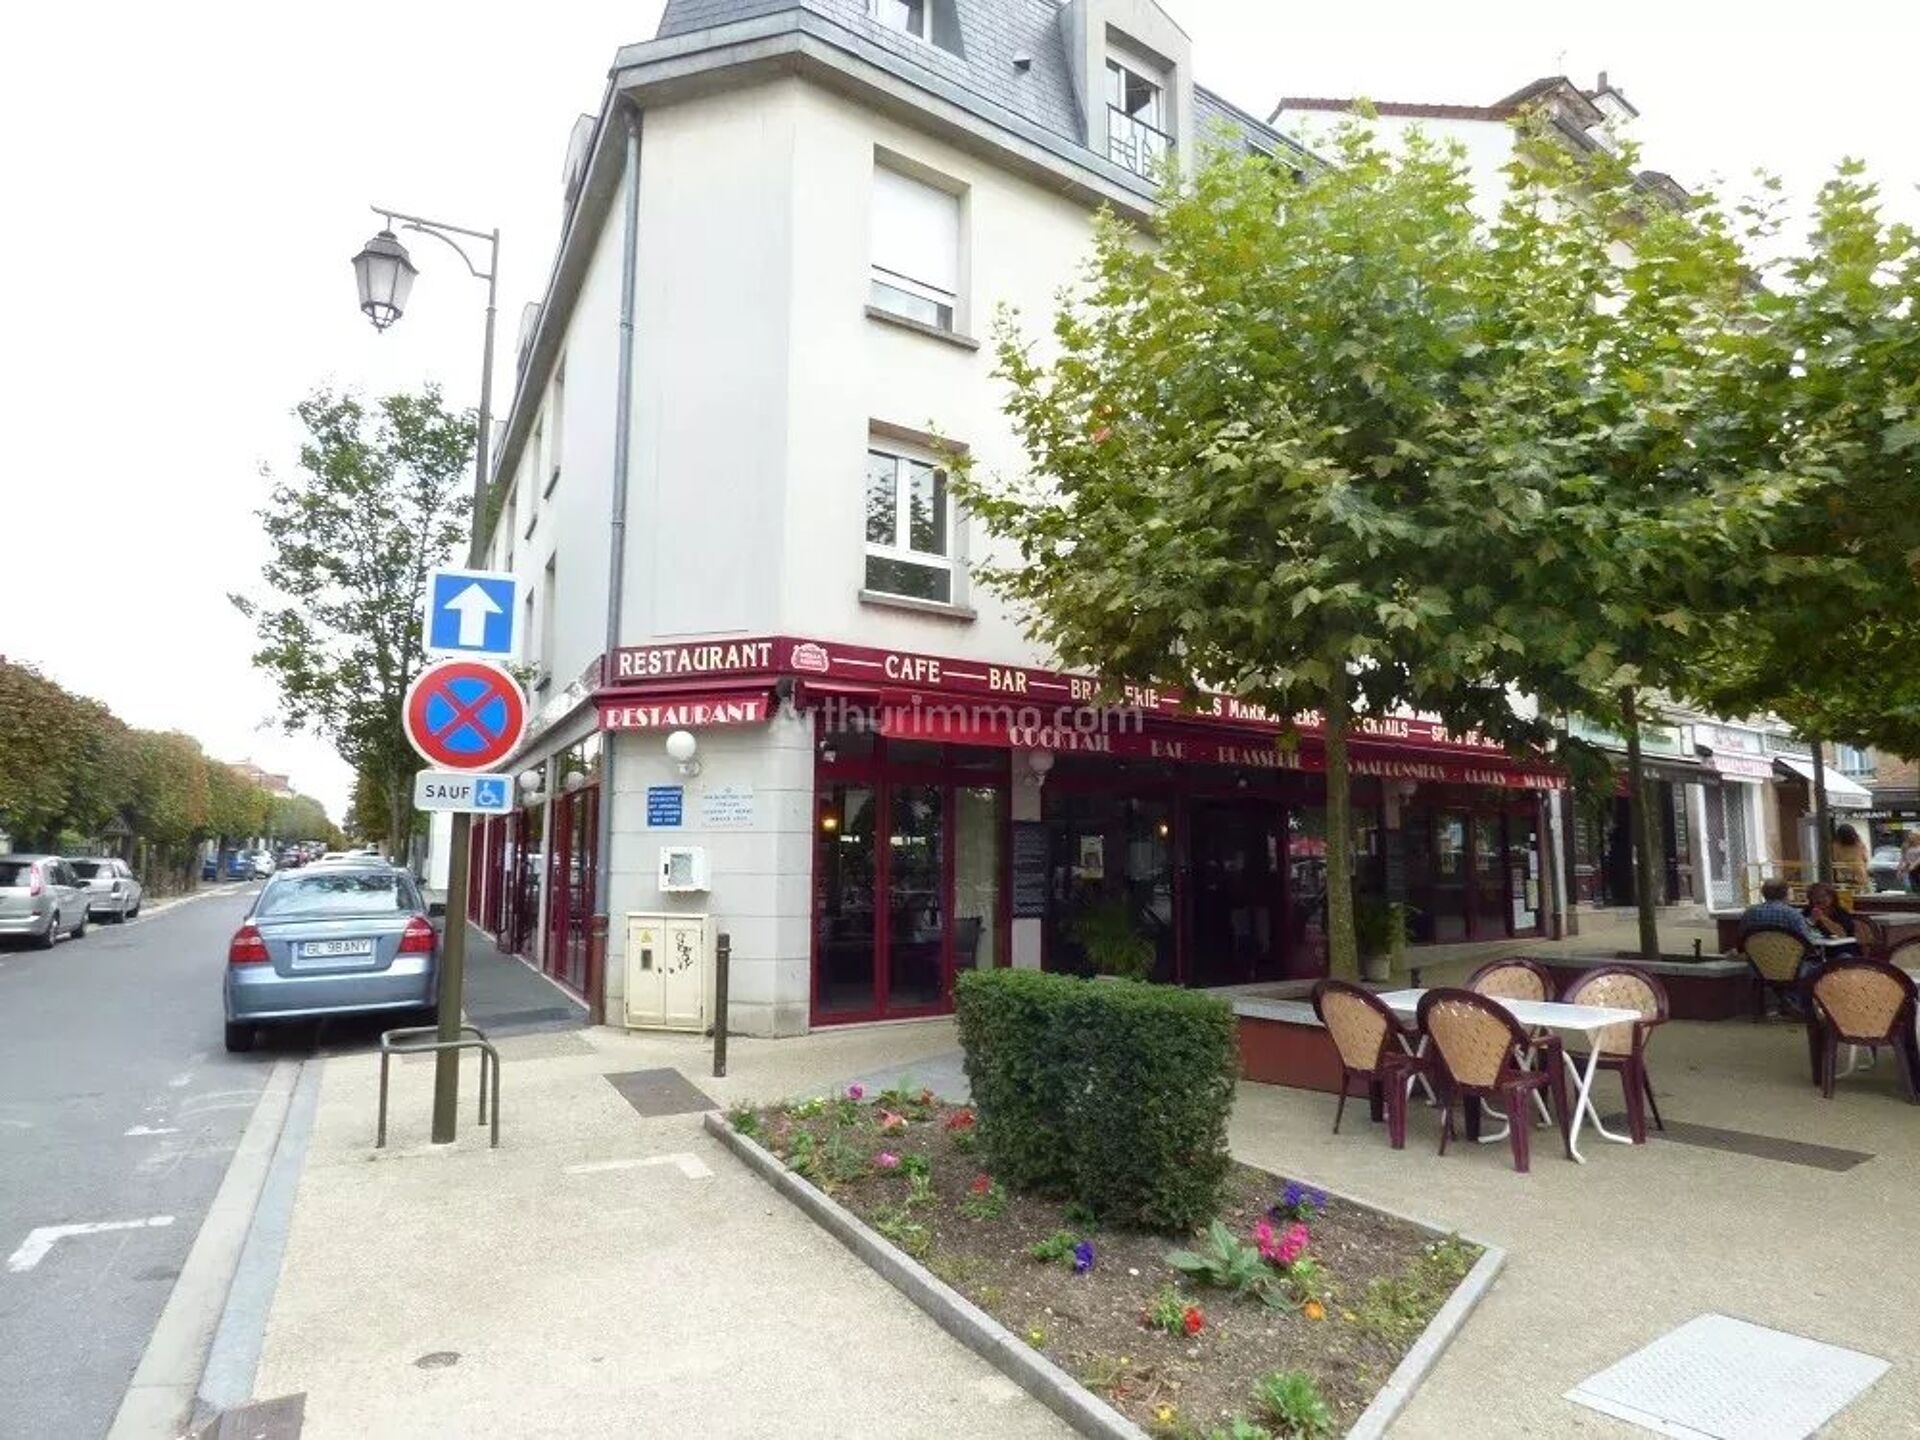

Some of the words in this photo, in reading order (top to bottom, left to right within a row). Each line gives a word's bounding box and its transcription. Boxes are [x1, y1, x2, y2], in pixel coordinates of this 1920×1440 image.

[619, 642, 773, 677] RESTAURANT
[884, 654, 941, 683] CAFE
[989, 668, 1028, 694] BAR
[605, 701, 761, 729] RESTAURANT
[1009, 726, 1115, 754] COCKTAIL
[425, 784, 471, 799] SAUF
